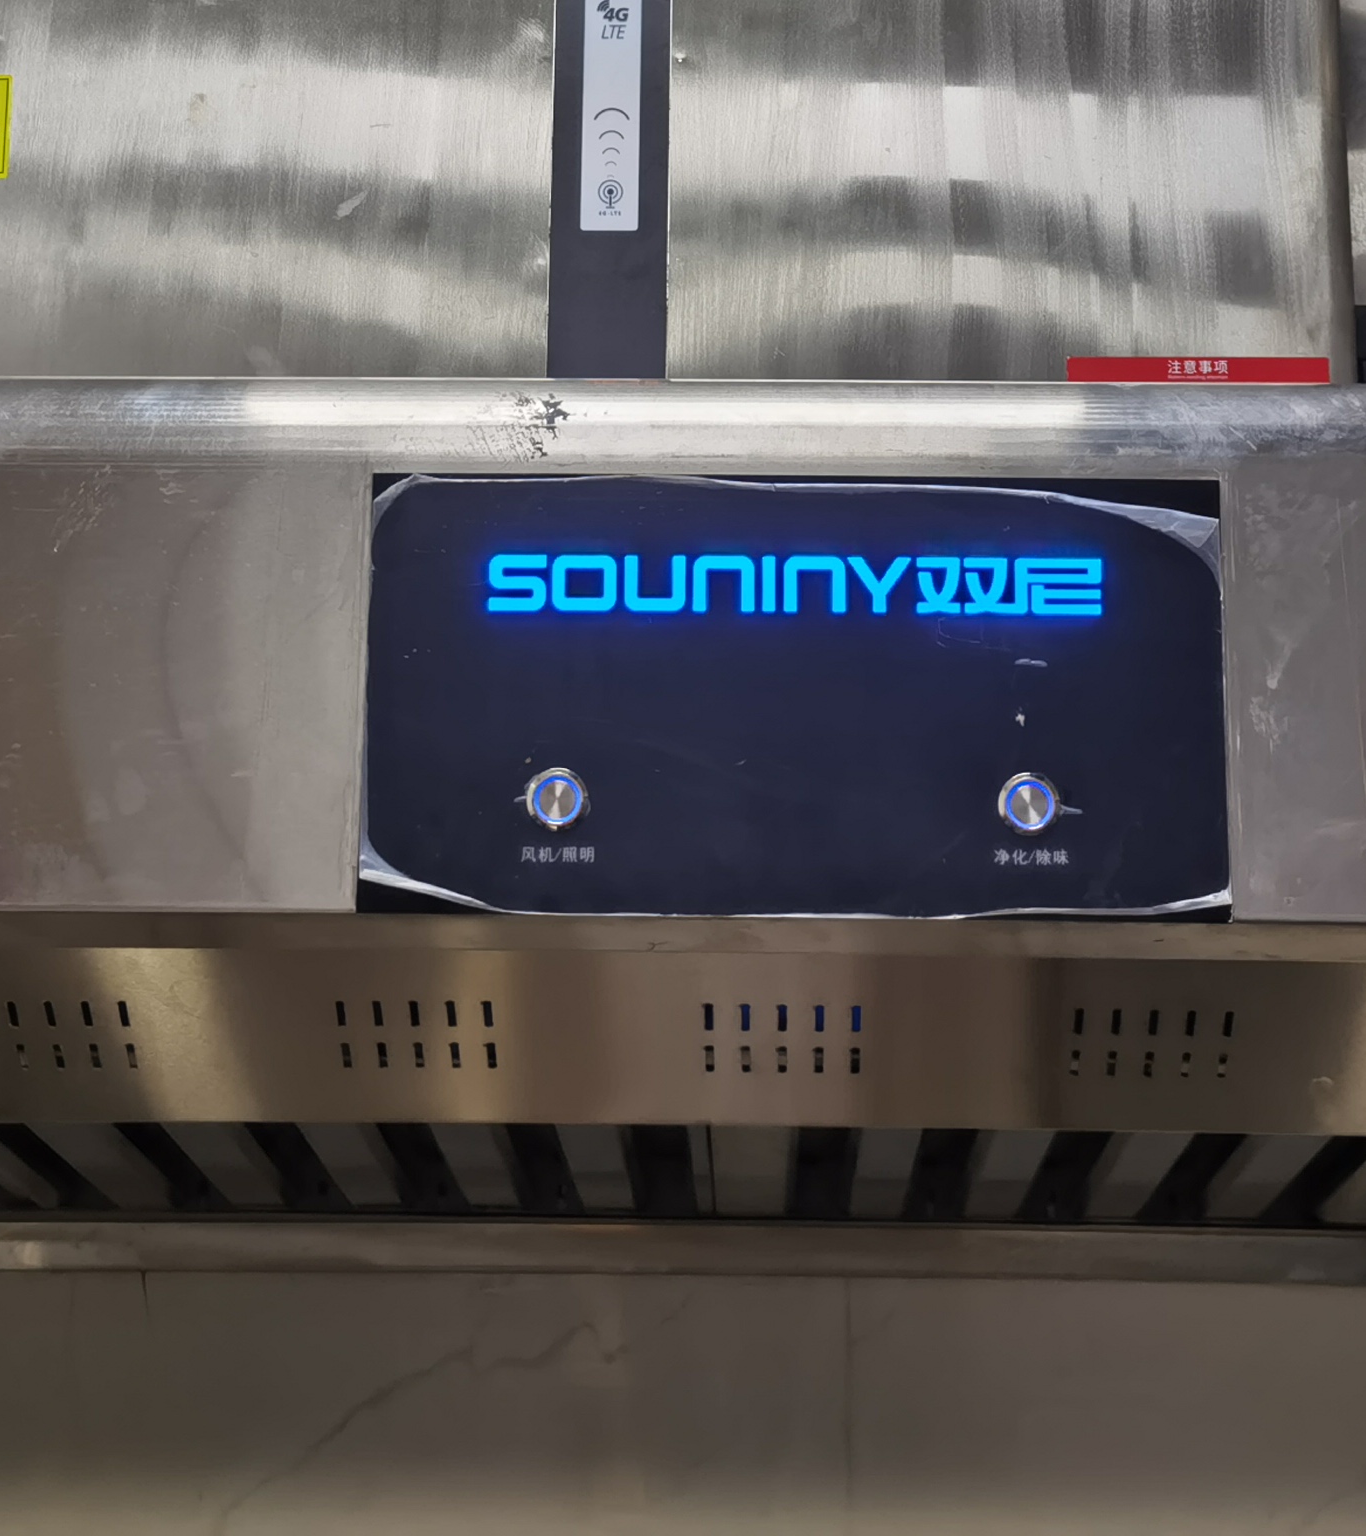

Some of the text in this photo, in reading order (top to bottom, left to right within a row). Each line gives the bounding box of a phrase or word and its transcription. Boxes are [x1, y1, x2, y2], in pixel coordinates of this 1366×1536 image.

[603, 7, 629, 23] 4G
[601, 25, 626, 39] LTE
[1167, 359, 1229, 375] 注意事项
[521, 846, 595, 863] 风机/照明
[993, 848, 1070, 866] 净化/除味
